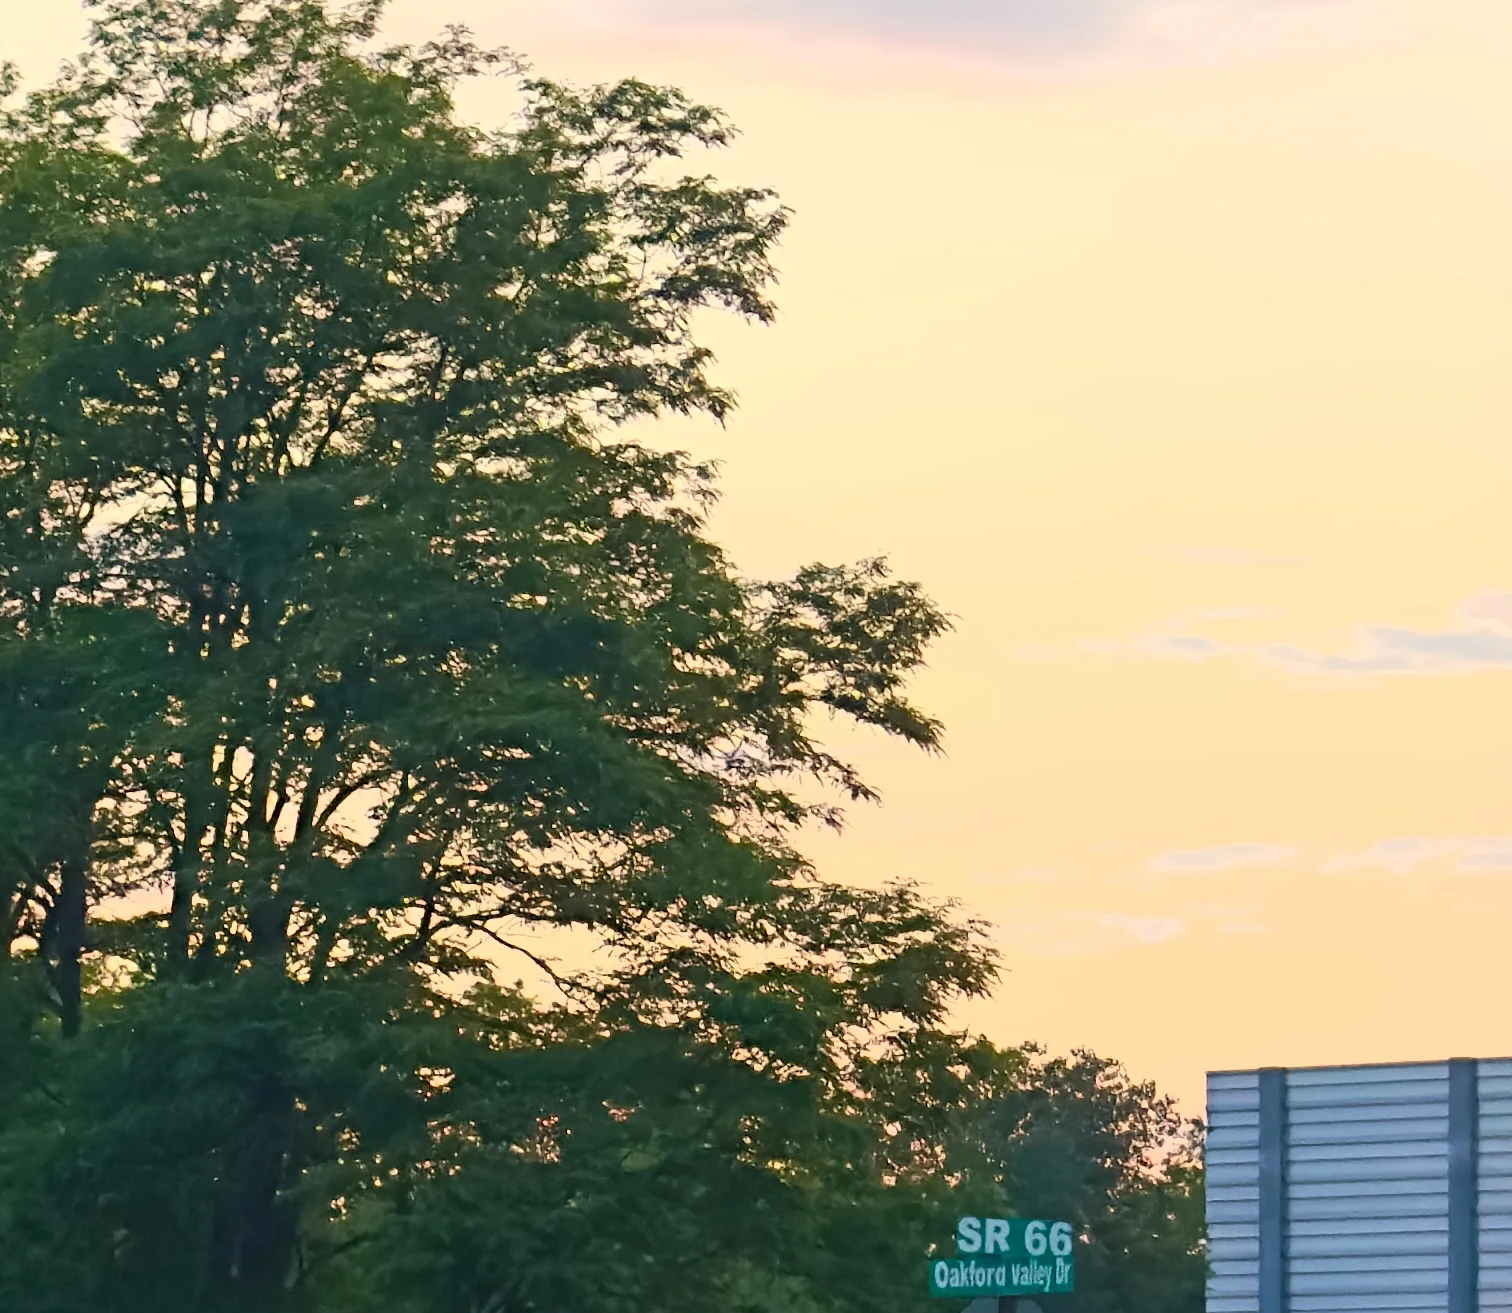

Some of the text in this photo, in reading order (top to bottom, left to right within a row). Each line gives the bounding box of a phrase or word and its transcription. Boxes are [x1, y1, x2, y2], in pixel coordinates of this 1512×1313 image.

[957, 1217, 1073, 1256] SR 66
[934, 1257, 1072, 1292] Oakford Valley Dr
